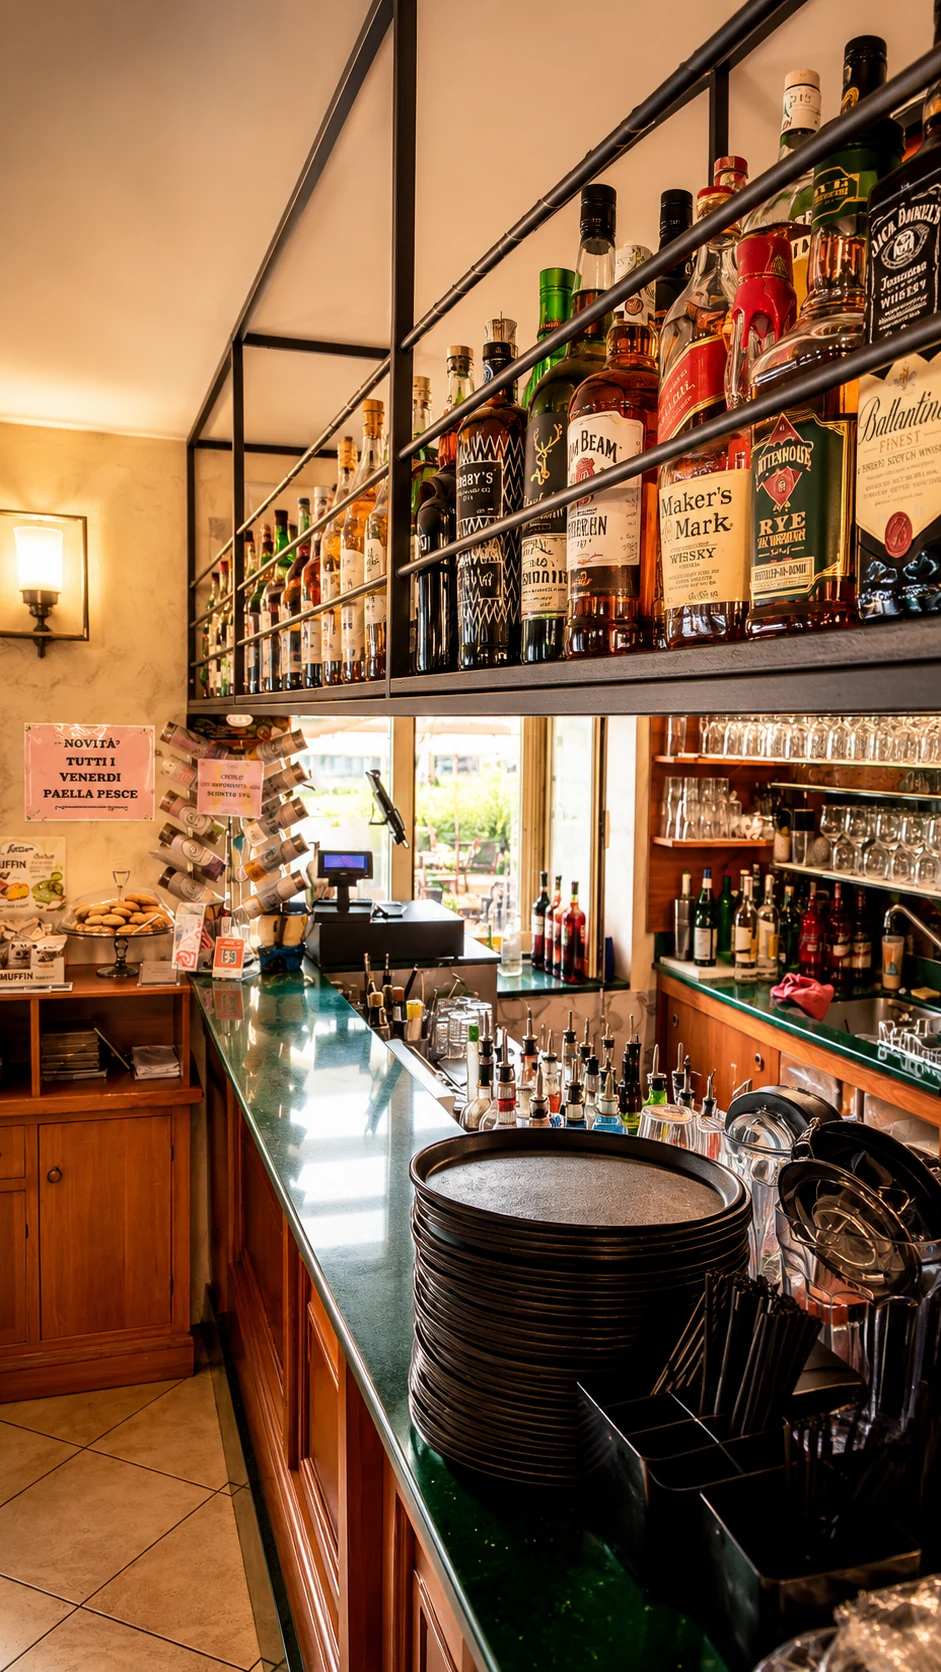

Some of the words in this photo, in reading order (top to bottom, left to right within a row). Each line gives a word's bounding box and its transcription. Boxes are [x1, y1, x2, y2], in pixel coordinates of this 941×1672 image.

[581, 430, 617, 463] BEAM
[879, 430, 921, 453] FINEST
[662, 487, 732, 519] Maker's
[675, 513, 731, 540] Mark
[759, 511, 806, 537] RYE
[64, 738, 117, 749] NOVITÀ
[66, 757, 107, 767] TUTTI
[110, 757, 116, 767] I
[59, 772, 121, 782] VENERDI
[43, 789, 94, 799] PAELLA
[97, 789, 138, 799] PESCE
